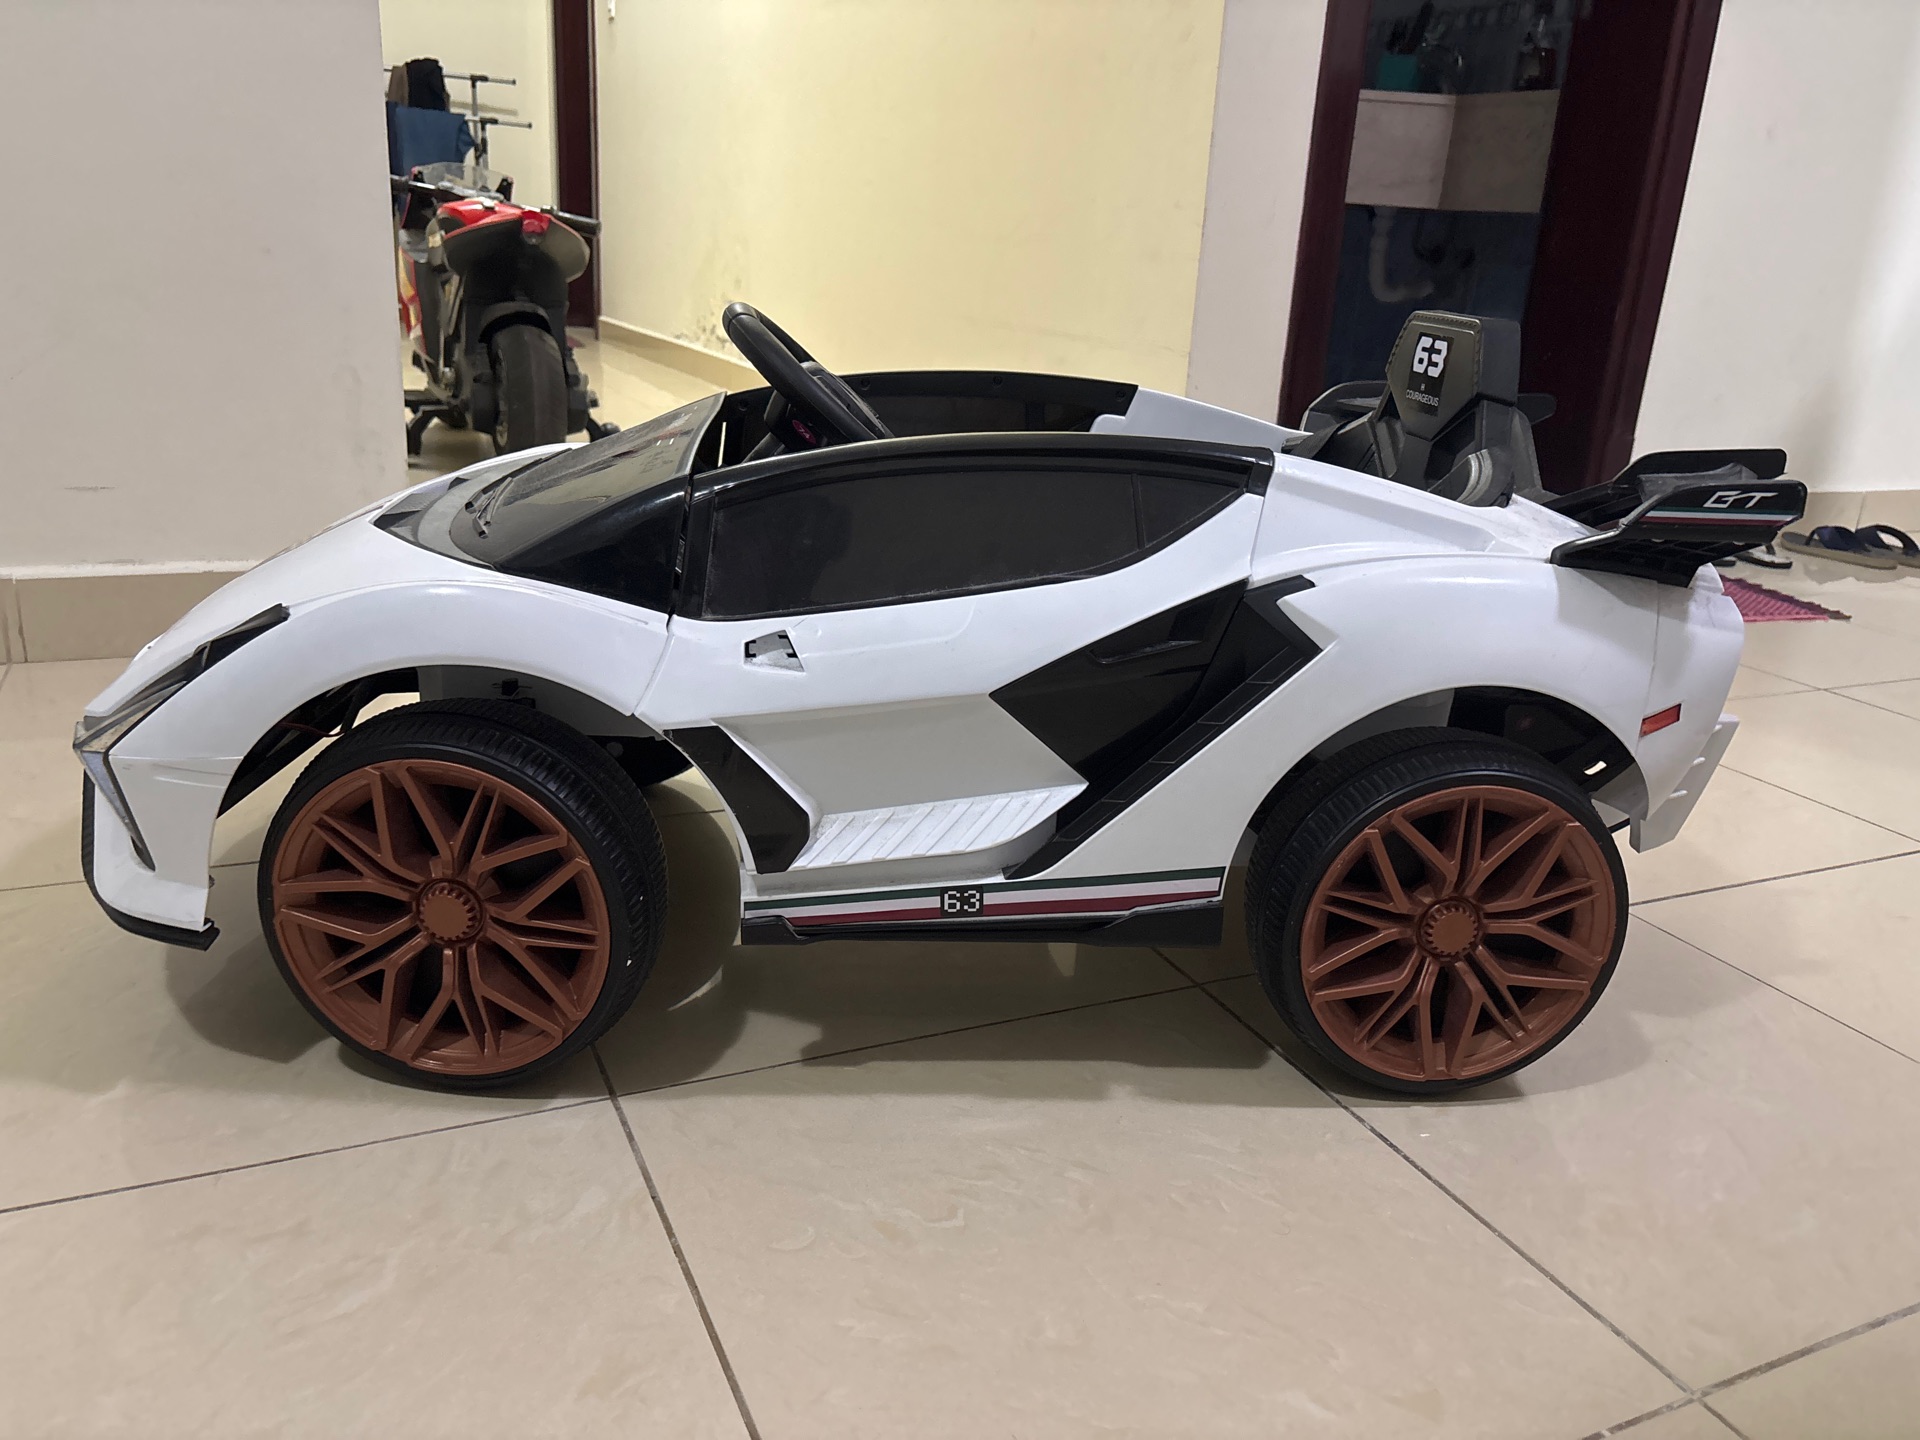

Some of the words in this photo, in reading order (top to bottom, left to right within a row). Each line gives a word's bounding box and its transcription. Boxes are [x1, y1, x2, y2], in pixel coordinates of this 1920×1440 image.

[1412, 335, 1448, 378] 63
[1405, 389, 1440, 407] COURAGEOUS
[1702, 490, 1779, 509] GT
[943, 890, 980, 912] 63
